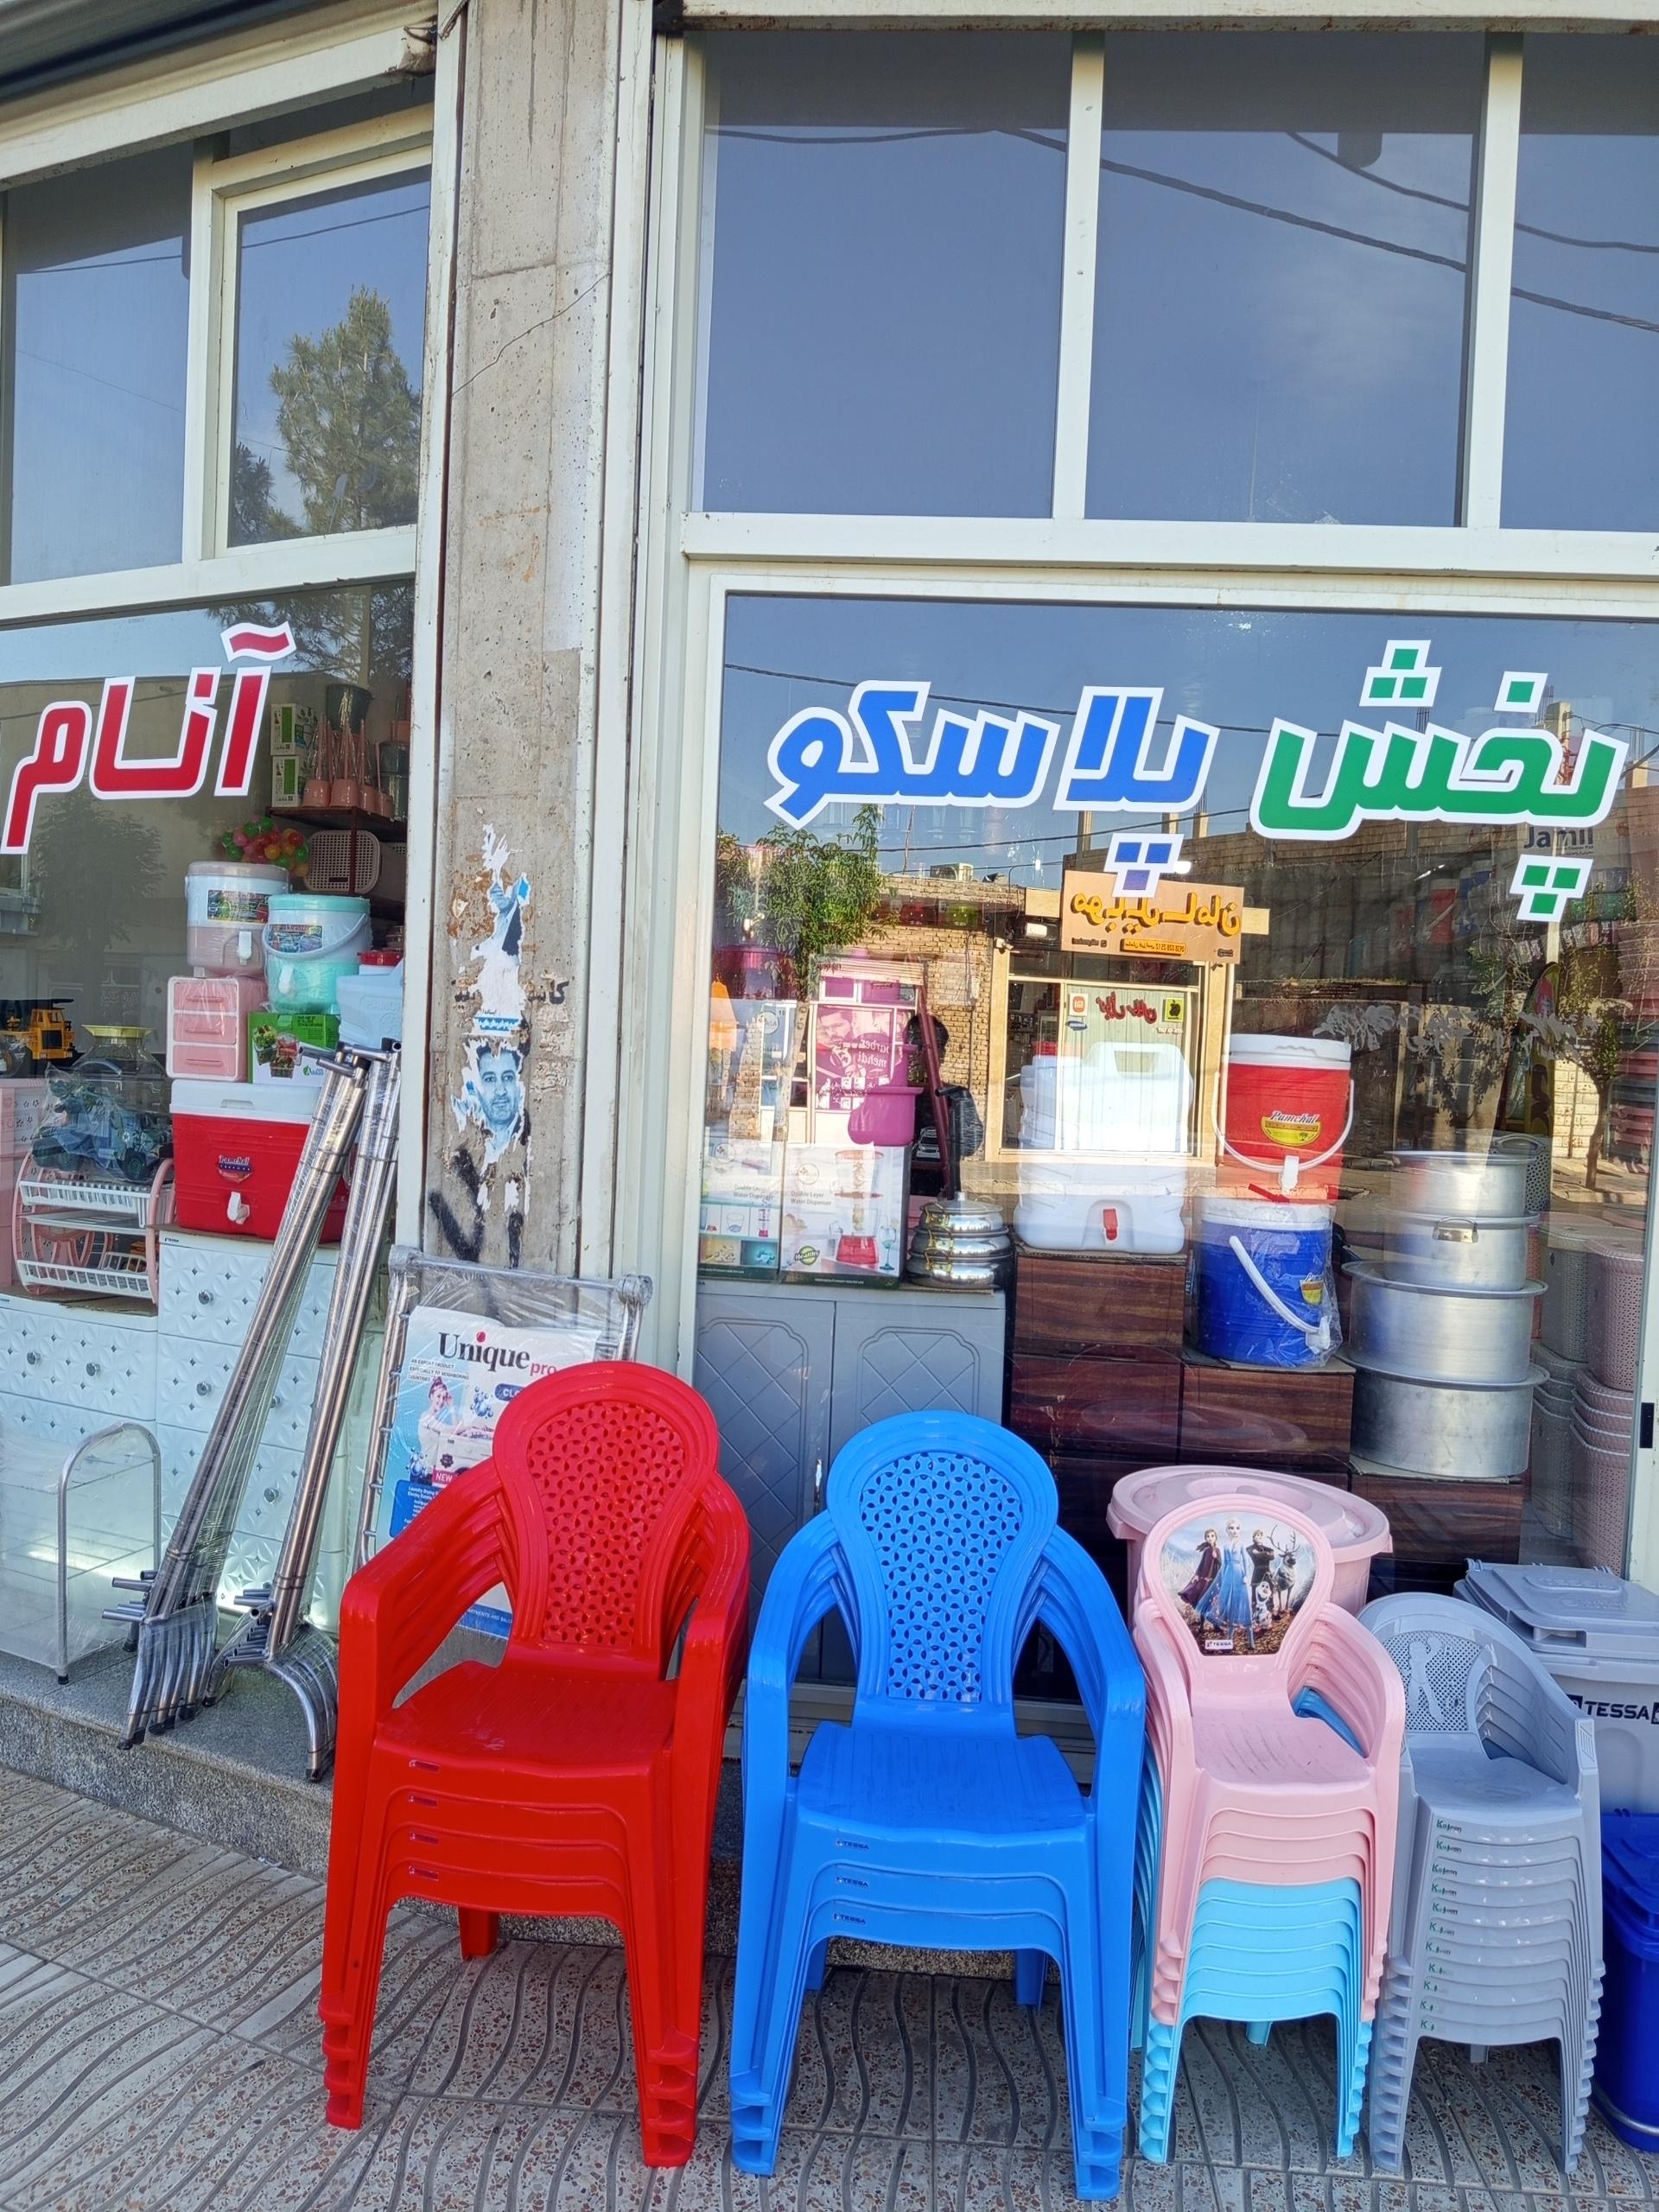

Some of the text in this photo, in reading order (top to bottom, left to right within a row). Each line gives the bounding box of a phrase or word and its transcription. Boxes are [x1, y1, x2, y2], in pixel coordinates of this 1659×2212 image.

[0, 621, 296, 854] آنام
[764, 639, 1629, 922] پخش پلاسکو
[438, 1331, 557, 1376] Unique pro
[435, 1471, 454, 1483] NEW
[1585, 1700, 1649, 1721] TESSA
